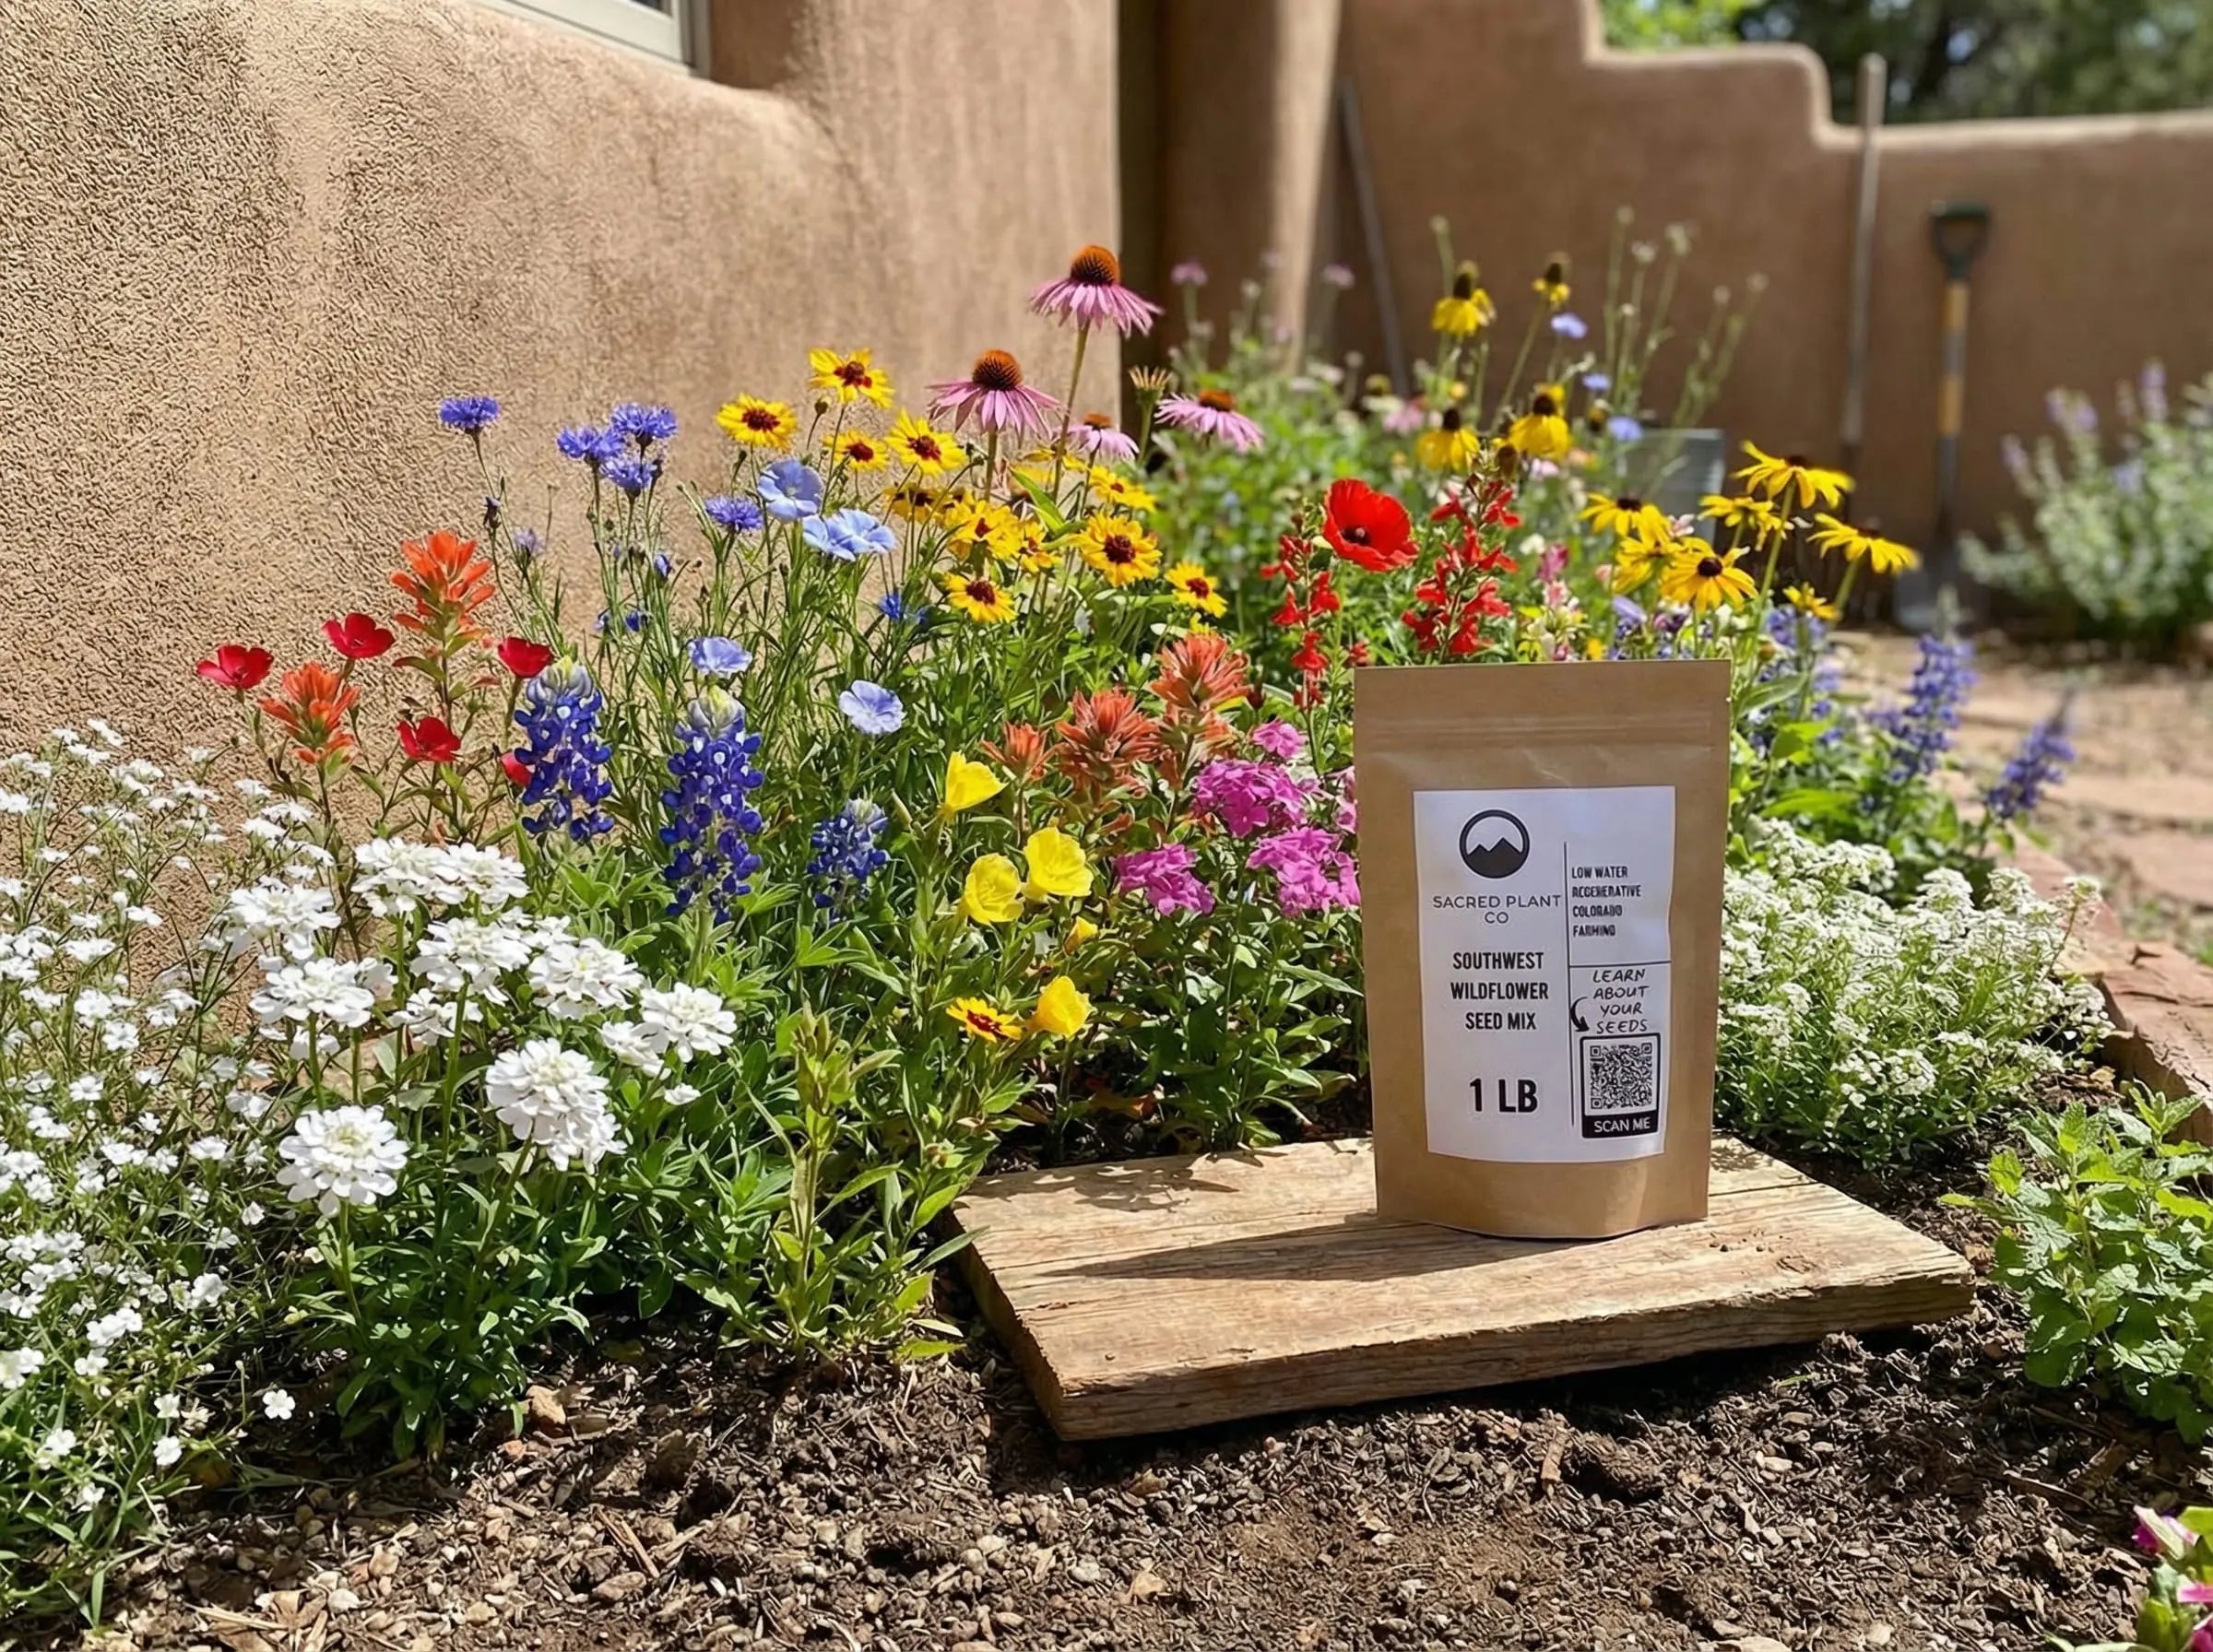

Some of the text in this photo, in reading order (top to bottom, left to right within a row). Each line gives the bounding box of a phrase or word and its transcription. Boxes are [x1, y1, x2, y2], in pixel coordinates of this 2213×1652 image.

[1571, 866, 1627, 879] LOW WATER
[1432, 894, 1561, 909] SACRED PLANT
[1485, 911, 1509, 924] CO
[1572, 904, 1623, 917] COLORADO
[1452, 951, 1544, 970] SOUTHWEST
[1592, 968, 1646, 983] LEARN
[1450, 981, 1549, 1000] WILDFLOWER
[1592, 985, 1651, 1000] ABOUT
[1600, 1002, 1643, 1018] YOUR
[1464, 1011, 1537, 1031] SEED MIX
[1596, 1019, 1649, 1034] SEEDS
[1469, 1078, 1539, 1113] 1 LB
[1593, 1116, 1651, 1133] SCAN ME
